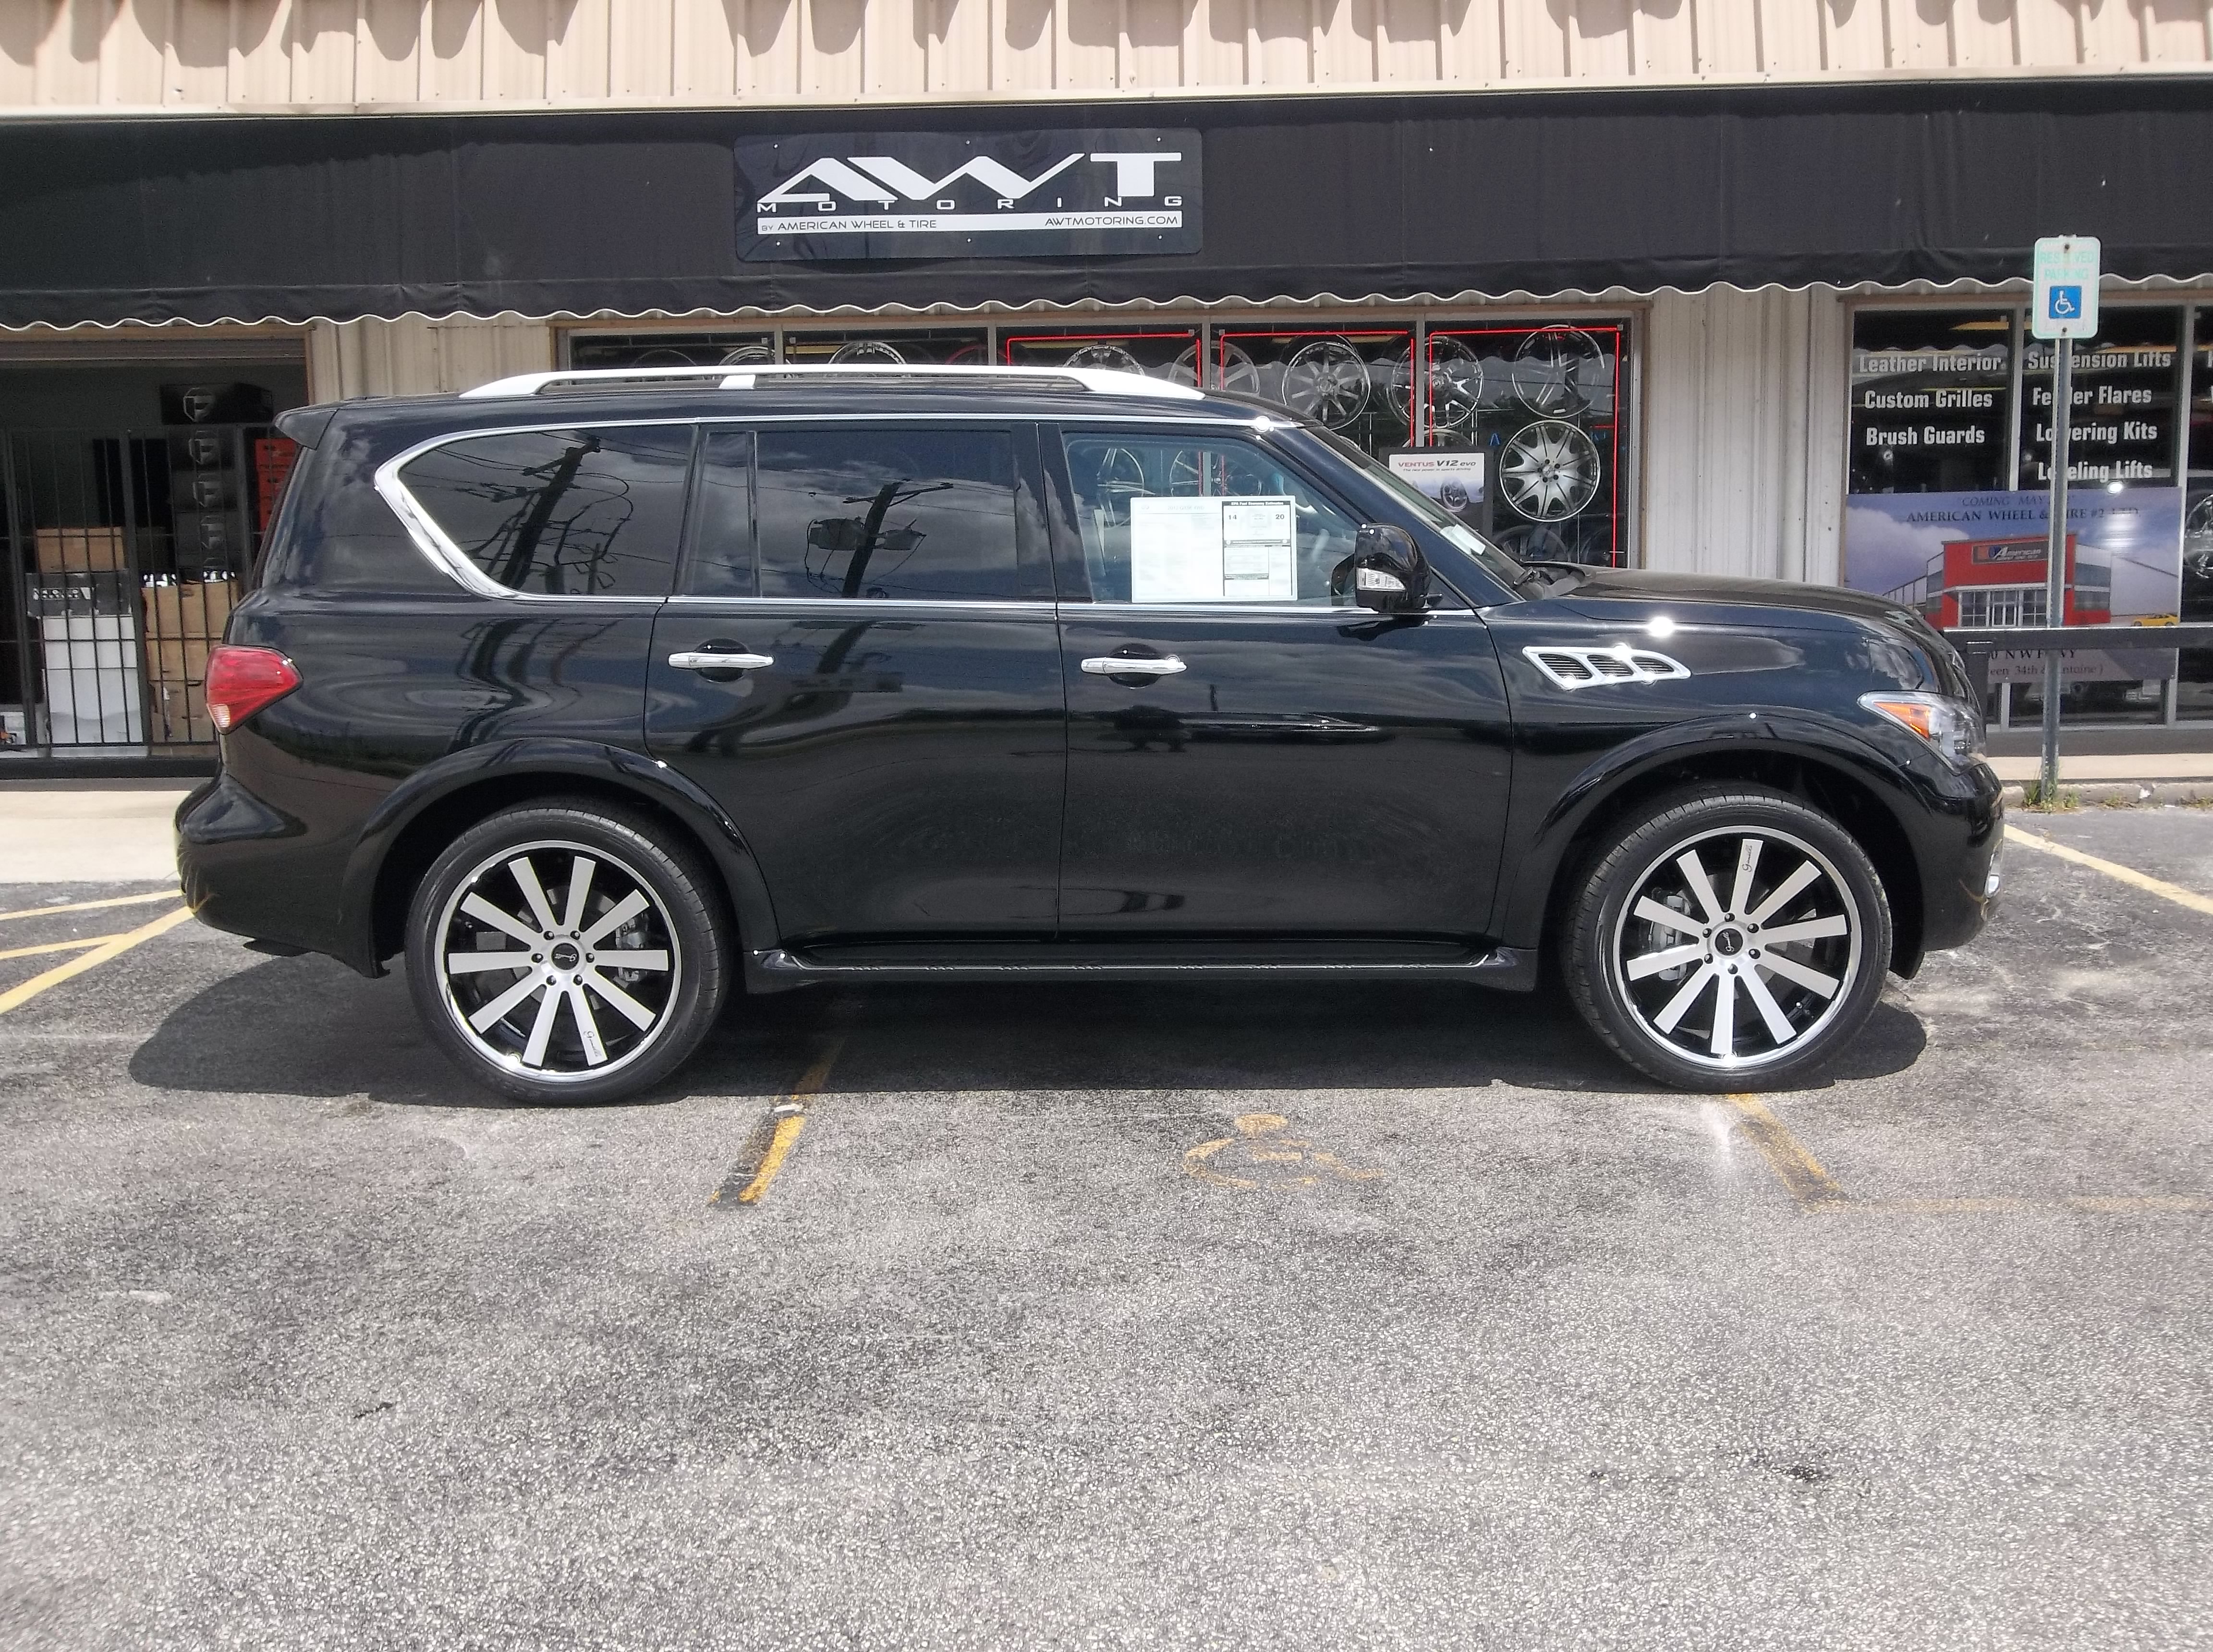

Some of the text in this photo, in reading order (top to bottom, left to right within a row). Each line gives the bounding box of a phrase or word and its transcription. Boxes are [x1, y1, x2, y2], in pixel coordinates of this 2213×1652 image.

[757, 152, 1182, 203] AWT
[757, 196, 1182, 213] MOTORING
[777, 221, 847, 231] AMERICAN
[851, 220, 894, 229] WHEEL
[909, 219, 936, 228] TIRE
[1045, 215, 1178, 226] AWTMOTORING.COM
[1859, 353, 2002, 373] Leather Interior
[2028, 351, 2171, 369] Susension Lifts
[1865, 389, 1993, 409] Custom Grilles
[2032, 386, 2152, 405] Feer Flares
[1866, 425, 1985, 446] Brush Guards
[2124, 421, 2158, 440] Kits
[2116, 460, 2153, 479] Lifts
[1907, 510, 1981, 522] AMERICAN
[1989, 510, 2034, 521] WHEEL
[2067, 508, 2087, 519] IRE
